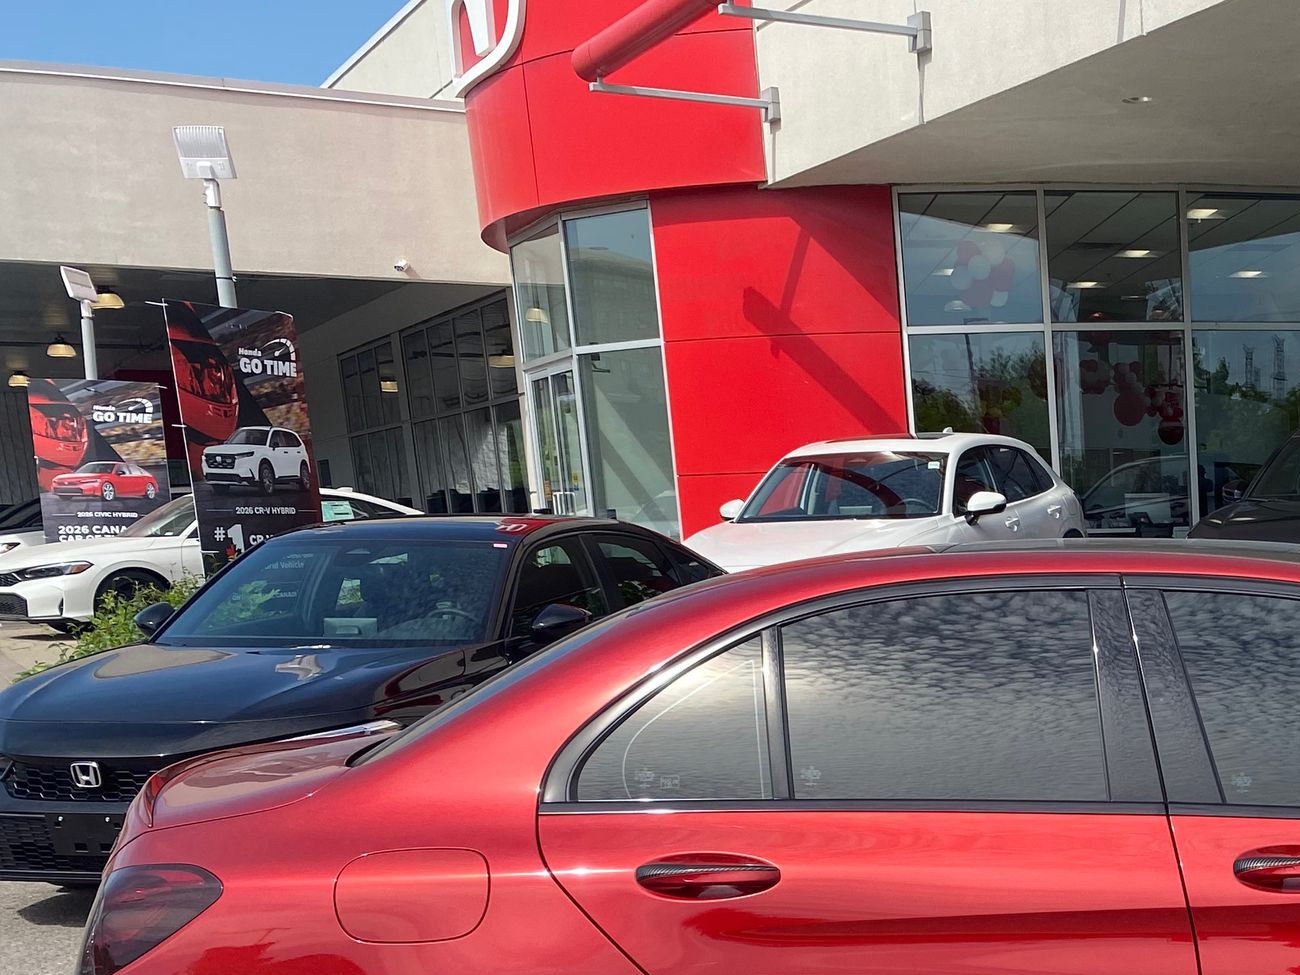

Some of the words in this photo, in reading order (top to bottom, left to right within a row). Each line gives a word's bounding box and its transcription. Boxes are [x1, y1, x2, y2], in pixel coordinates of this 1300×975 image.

[238, 347, 262, 357] Honda
[239, 357, 263, 374] GO
[263, 359, 297, 377] TIME
[92, 411, 115, 423] GO
[116, 412, 153, 424] TIME
[235, 507, 254, 515] 2026
[254, 507, 271, 515] CR-V
[271, 507, 296, 515] HYBRID
[58, 525, 89, 535] 2026
[91, 525, 128, 534] CANA
